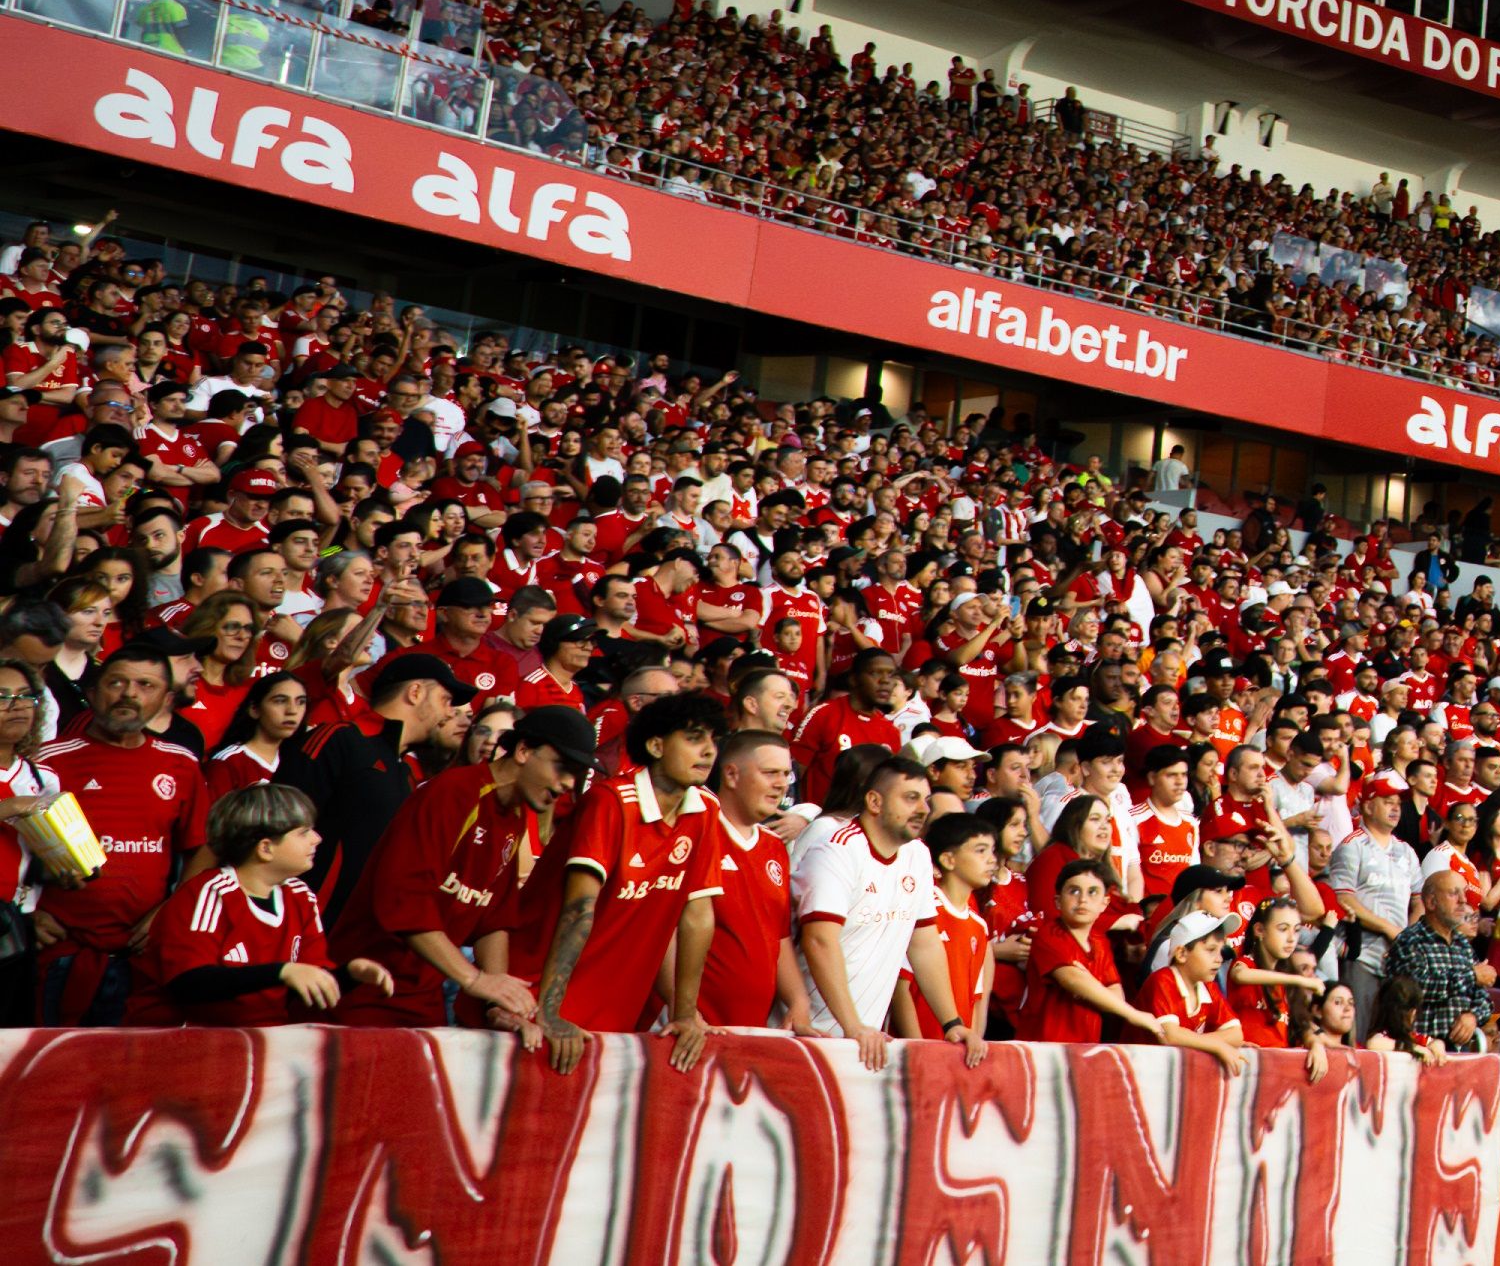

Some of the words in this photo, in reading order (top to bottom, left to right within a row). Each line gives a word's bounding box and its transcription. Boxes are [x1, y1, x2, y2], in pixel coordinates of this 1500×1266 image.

[1423, 26, 1480, 82] DO
[93, 67, 356, 194] alfa
[412, 150, 632, 262] alfa
[926, 286, 1189, 382] alfa.bet.br
